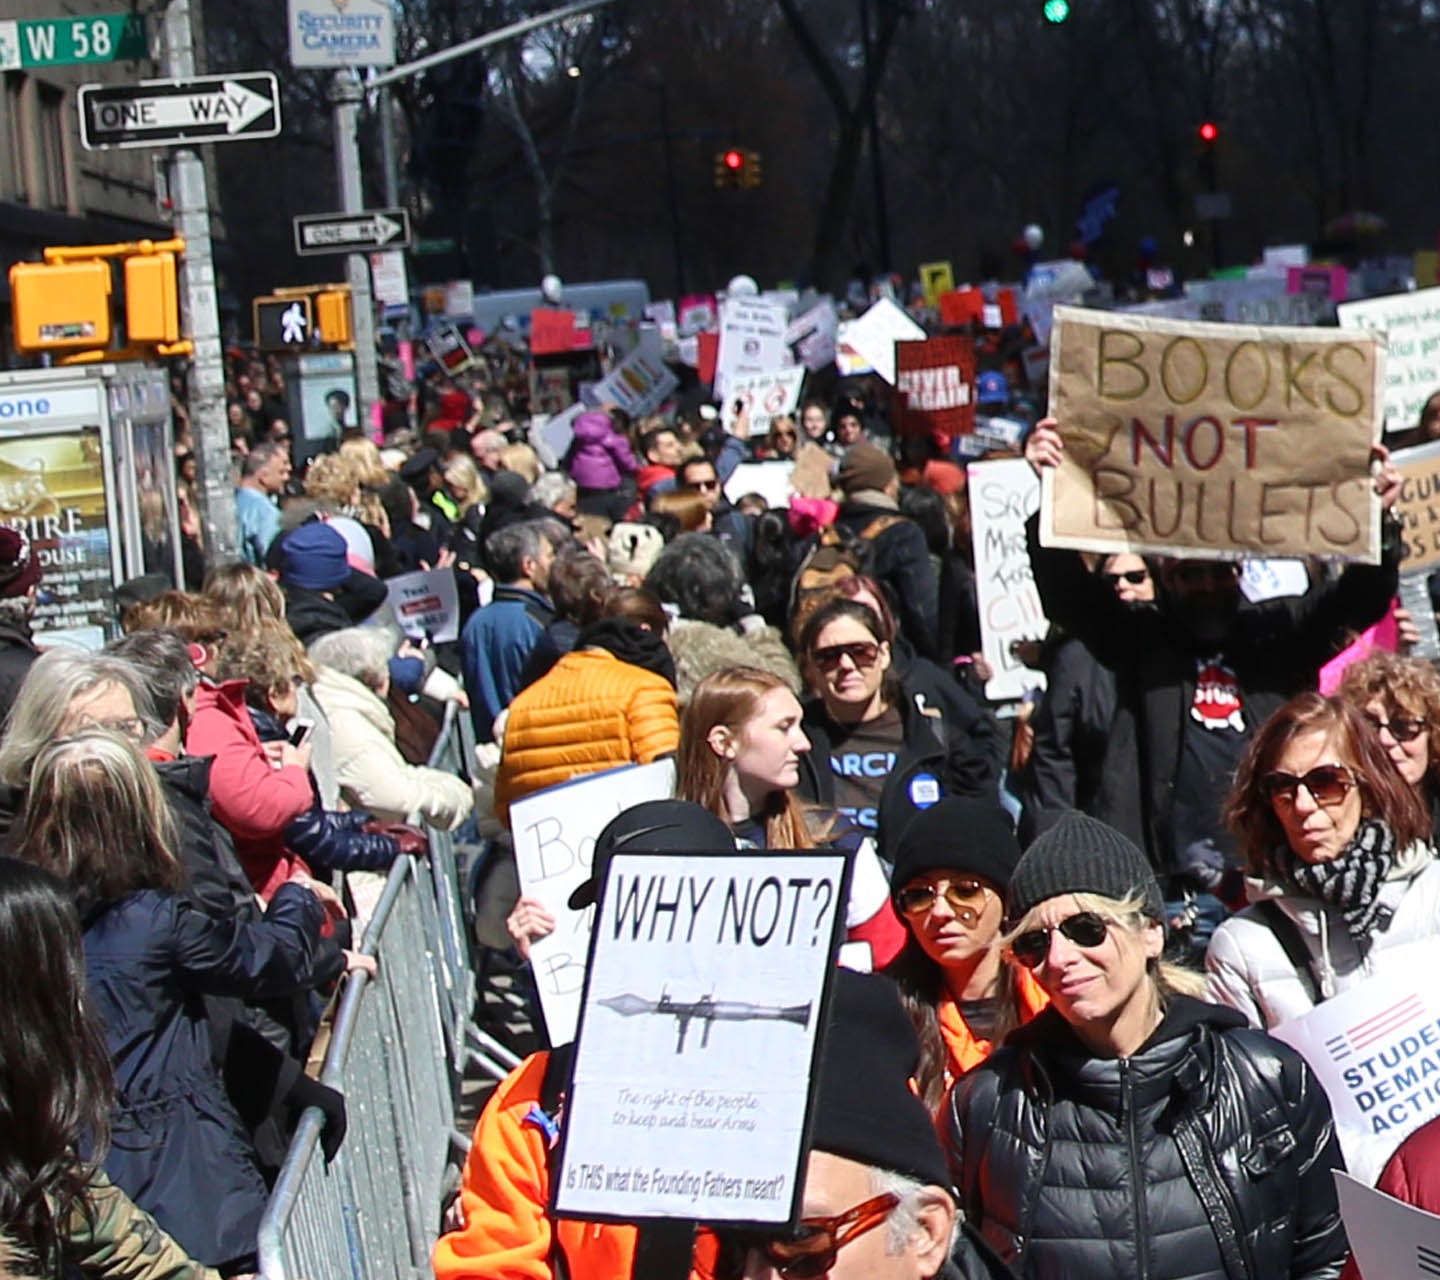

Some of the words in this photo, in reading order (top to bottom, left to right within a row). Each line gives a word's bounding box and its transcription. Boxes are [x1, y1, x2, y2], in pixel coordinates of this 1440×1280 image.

[26, 23, 56, 62] W
[71, 19, 112, 61] 58
[101, 103, 156, 126] ONE
[189, 96, 248, 121] WAY
[313, 228, 343, 242] ONE
[359, 223, 392, 240] WAY
[897, 366, 960, 392] NEVER
[1097, 329, 1367, 418] BOOKS
[907, 386, 970, 412] AGAIN
[1130, 414, 1280, 471] NOT
[1093, 466, 1362, 547] BULLETS
[10, 507, 82, 544] PIRE
[612, 873, 716, 943] WHY
[716, 875, 835, 948] NOT?
[616, 1087, 641, 1108] The
[643, 1090, 680, 1117] right
[679, 1089, 696, 1113] of
[695, 1090, 715, 1110] the
[714, 1092, 761, 1115] people
[611, 1110, 627, 1130] to
[628, 1110, 656, 1135] keep
[658, 1112, 690, 1131] and
[690, 1114, 719, 1133] bear
[565, 1164, 577, 1191] Is
[578, 1163, 604, 1191] THIS
[603, 1166, 632, 1193] what
[631, 1168, 649, 1194] the
[647, 1168, 701, 1203] Founding
[701, 1169, 745, 1201] Fathers
[744, 1175, 786, 1202] meant?
